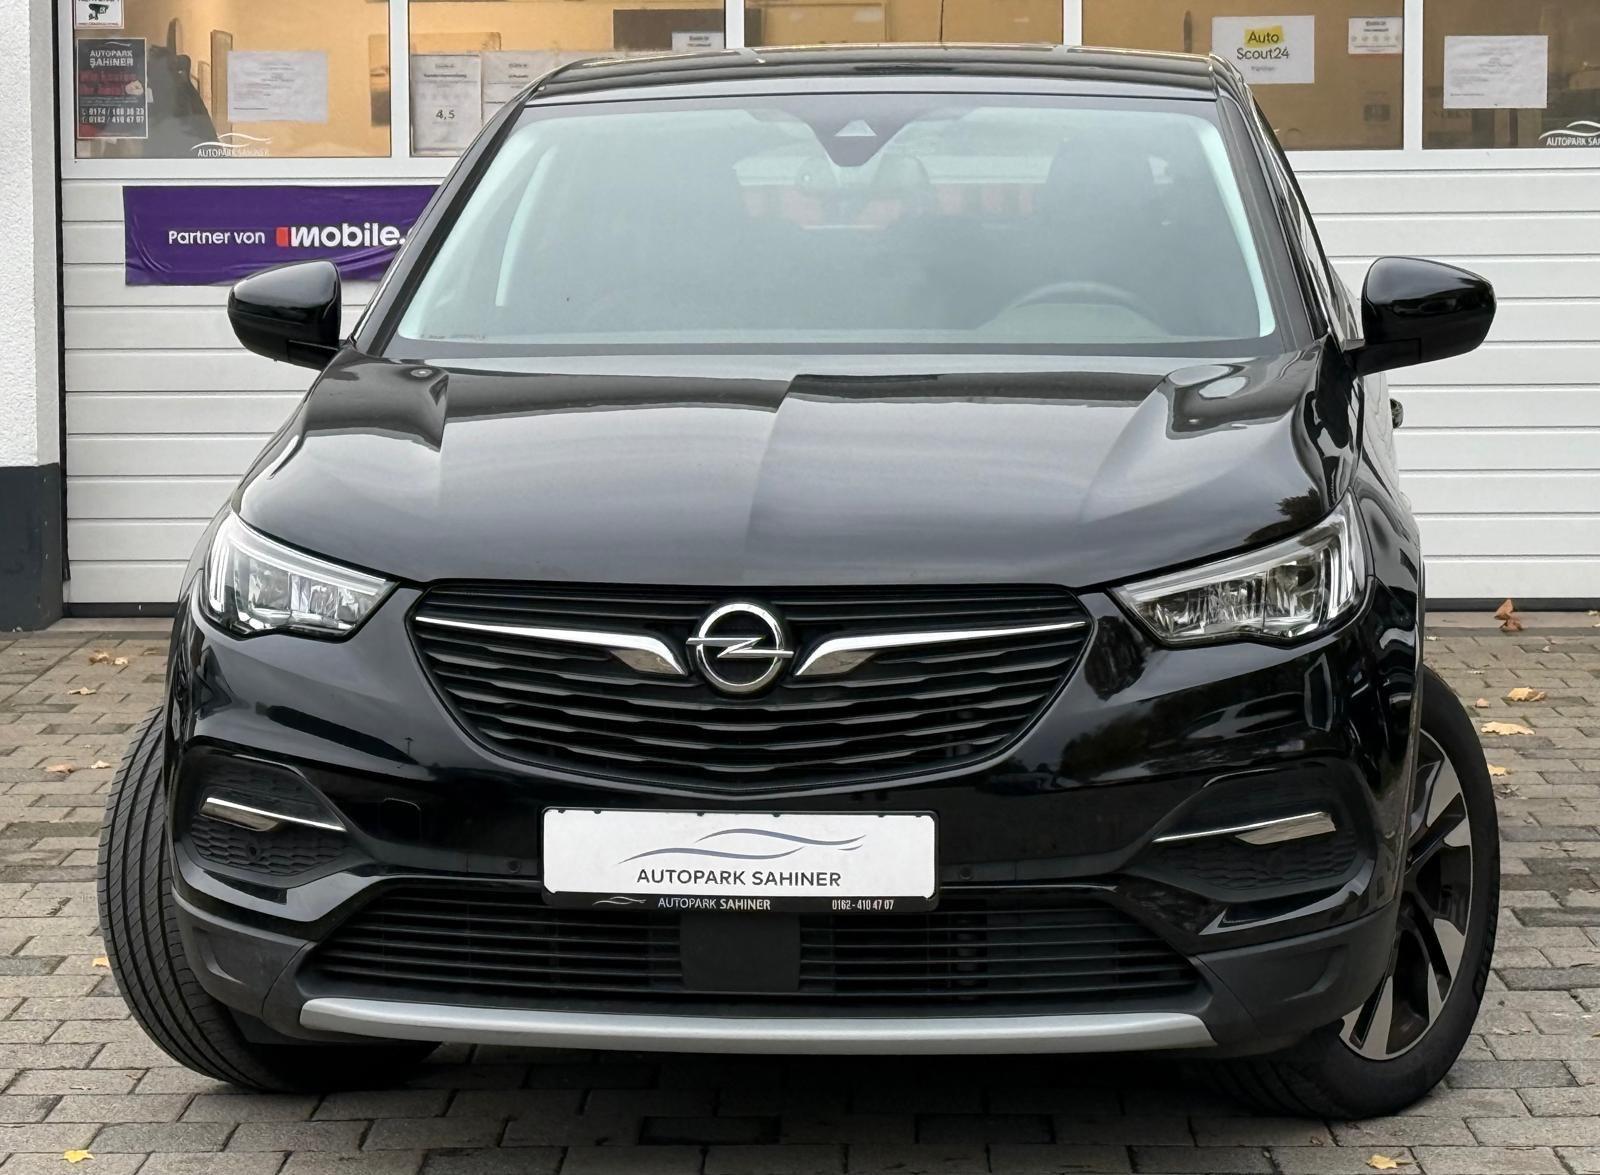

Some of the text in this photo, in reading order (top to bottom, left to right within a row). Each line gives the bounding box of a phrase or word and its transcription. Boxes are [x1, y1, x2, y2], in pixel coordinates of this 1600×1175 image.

[1248, 31, 1280, 44] Auto
[89, 50, 133, 58] AUTOPARK
[1236, 46, 1290, 60] Scout24
[435, 109, 456, 120] 4,5
[1545, 136, 1587, 146] AUTOPARK
[168, 230, 231, 244] Partner
[233, 231, 266, 244] von
[636, 868, 842, 887] AUTOPARK SAHINER
[657, 897, 771, 911] AUTOPARK SAHINER
[831, 899, 851, 910] 0162
[857, 899, 871, 910] 410
[872, 899, 883, 910] 47
[884, 899, 895, 910] 07
